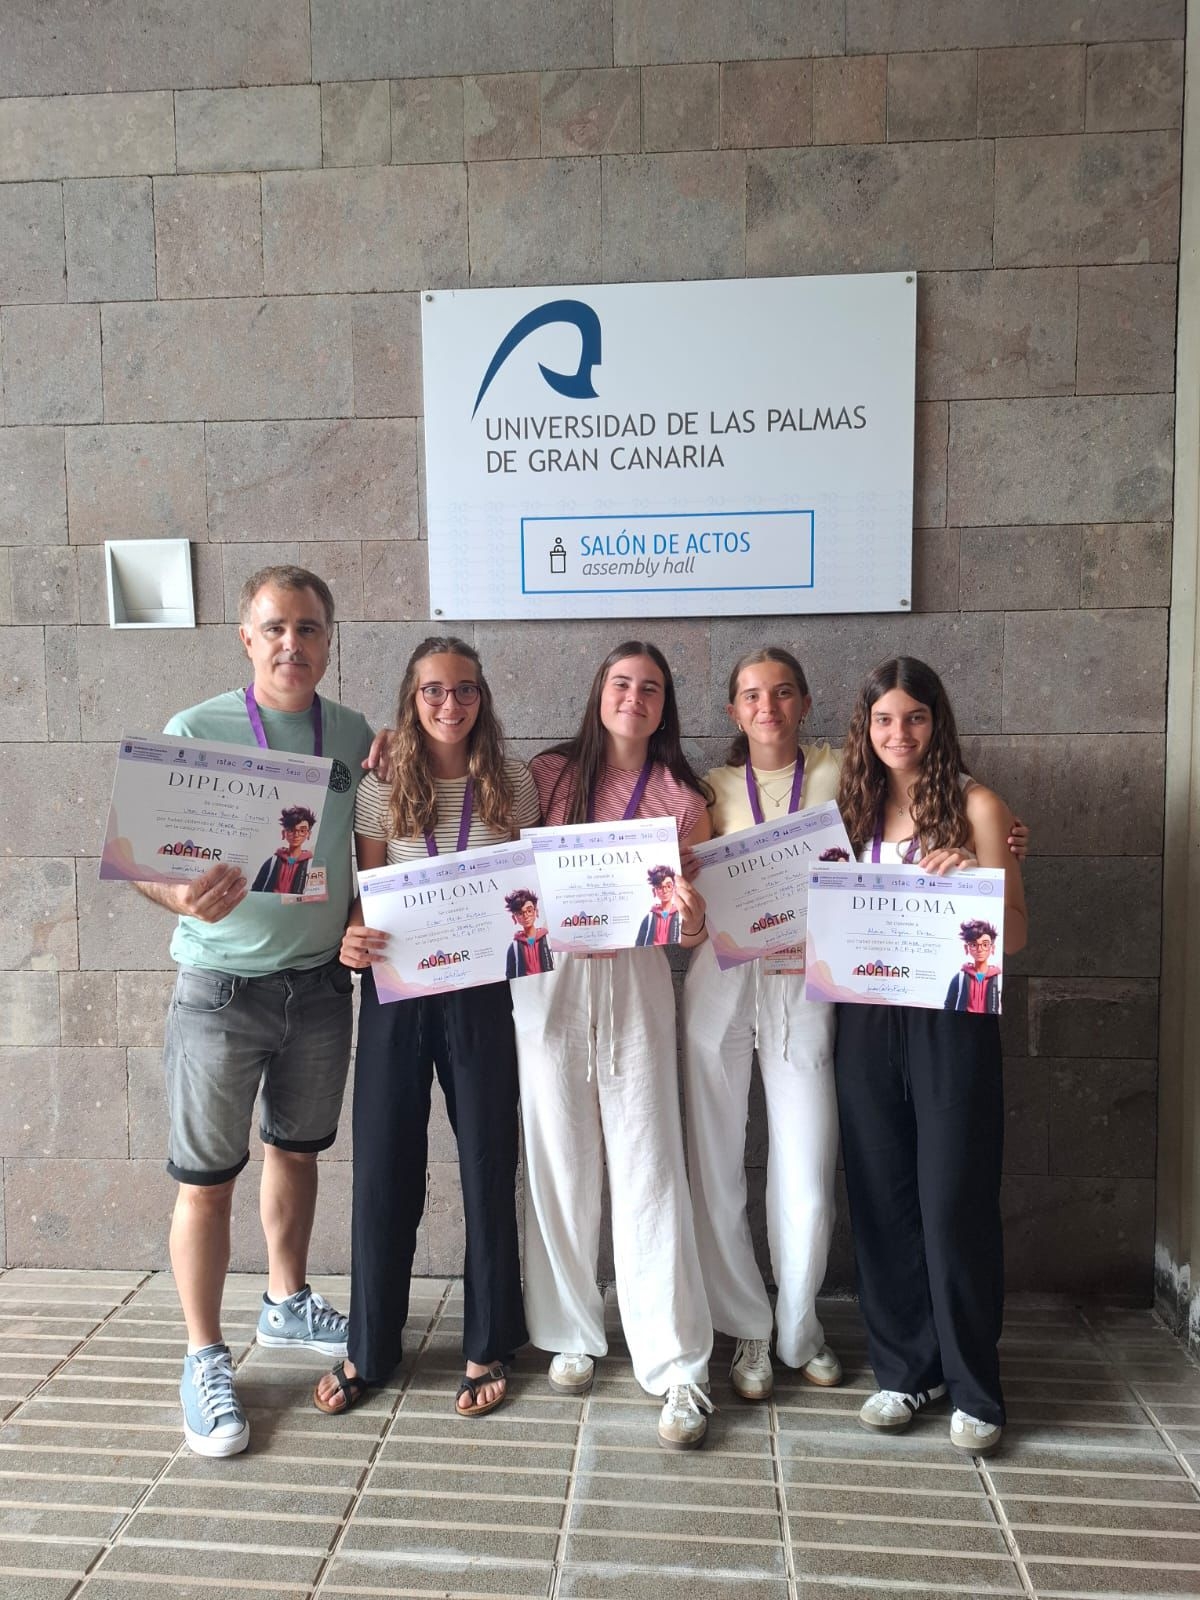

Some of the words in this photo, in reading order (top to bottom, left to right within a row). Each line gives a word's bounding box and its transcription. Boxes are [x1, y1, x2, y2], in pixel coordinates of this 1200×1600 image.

[486, 413, 656, 441] UNIVERSIDAD
[667, 411, 699, 436] DE
[710, 409, 756, 435] LAS
[767, 405, 867, 433] PALMAS
[487, 450, 517, 473] DE
[528, 448, 598, 473] GRAN
[610, 444, 725, 471] CANARIA
[580, 529, 646, 556] SALÓN
[653, 533, 680, 555] DE
[686, 532, 751, 554] ACTOS
[582, 557, 660, 578] assembly
[663, 556, 695, 574] hall
[168, 771, 280, 800] DIPLOMA
[558, 850, 643, 869] DIPLOMA
[727, 841, 813, 878] DIPLOMA
[403, 878, 499, 909] DIPLOMA
[853, 895, 956, 915] DIPLOMA
